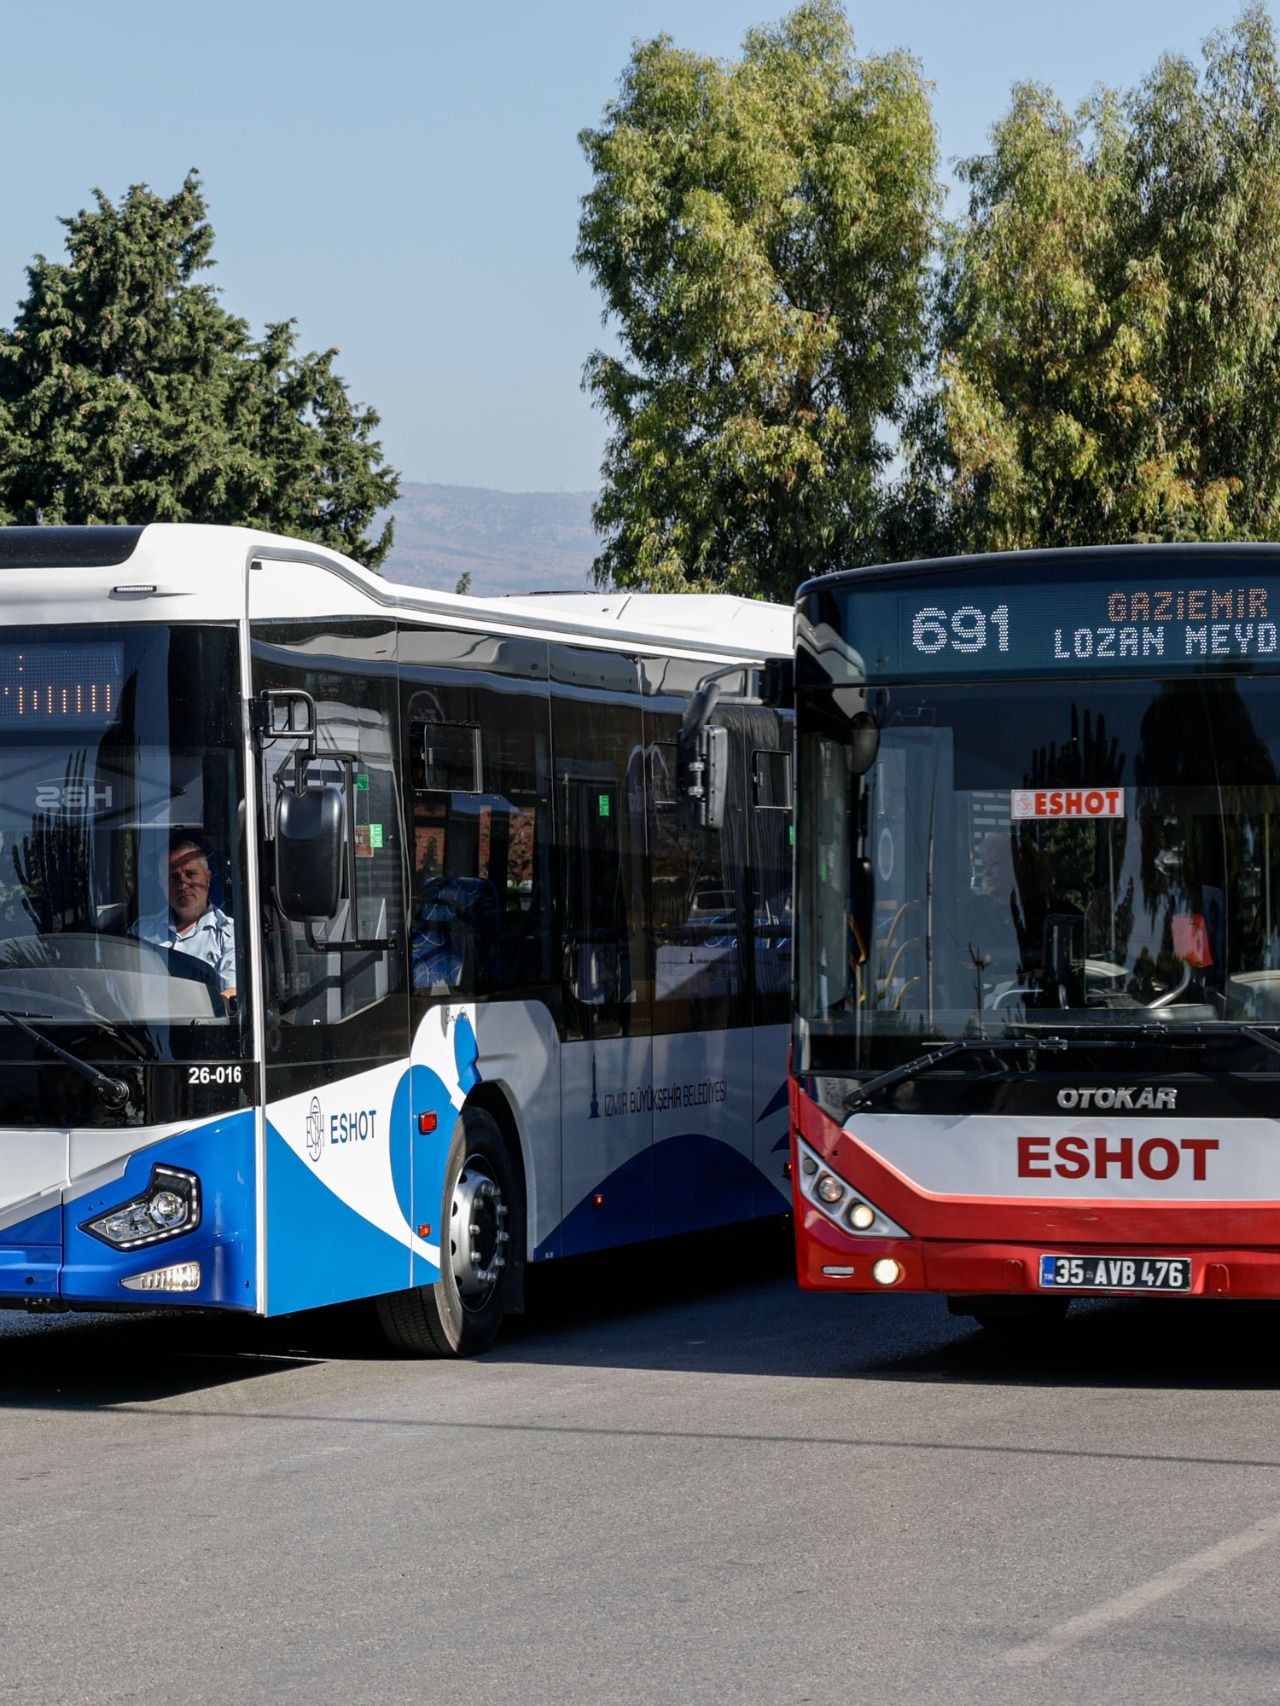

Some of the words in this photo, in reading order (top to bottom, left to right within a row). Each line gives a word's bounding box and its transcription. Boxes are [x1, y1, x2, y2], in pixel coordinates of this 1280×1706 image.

[912, 604, 1009, 654] 691
[1054, 626, 1165, 658] LOZAN
[1185, 622, 1279, 655] MEYD
[1035, 791, 1119, 815] ESHOT
[188, 1065, 242, 1084] 26-016
[1056, 1087, 1178, 1109] OTOKAR
[331, 1110, 376, 1144] ESHOT
[1017, 1136, 1219, 1181] ESHOT
[1055, 1259, 1084, 1284] 35
[1094, 1260, 1136, 1285] AVB
[1141, 1261, 1183, 1287] 476
